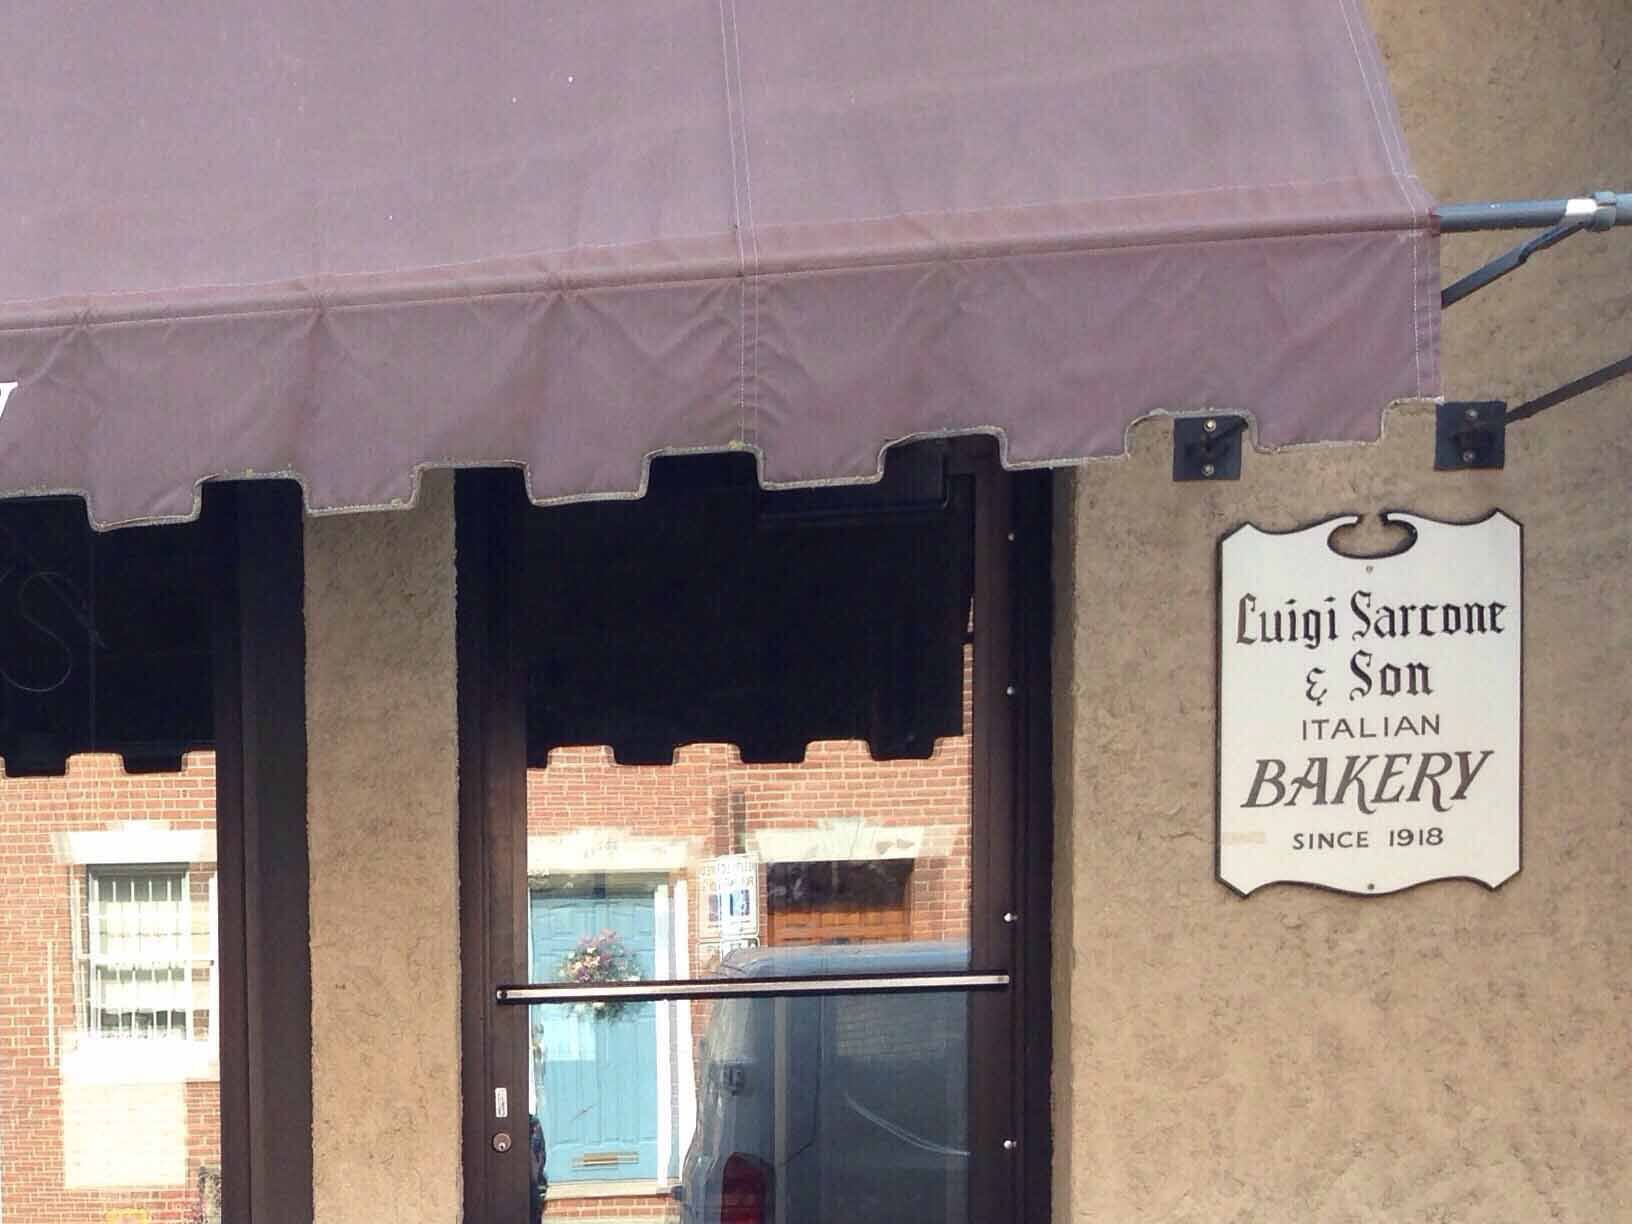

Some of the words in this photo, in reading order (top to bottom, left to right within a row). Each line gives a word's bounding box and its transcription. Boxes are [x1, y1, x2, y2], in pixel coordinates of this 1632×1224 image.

[1235, 591, 1340, 650] Luigi
[1349, 590, 1509, 642] Sarcone
[1305, 667, 1329, 707] &
[1349, 649, 1435, 702] Son
[1302, 714, 1441, 741] ITALIAN
[1240, 750, 1495, 815] BAKERY
[1292, 831, 1370, 851] SINCE
[1388, 827, 1445, 848] 1918
